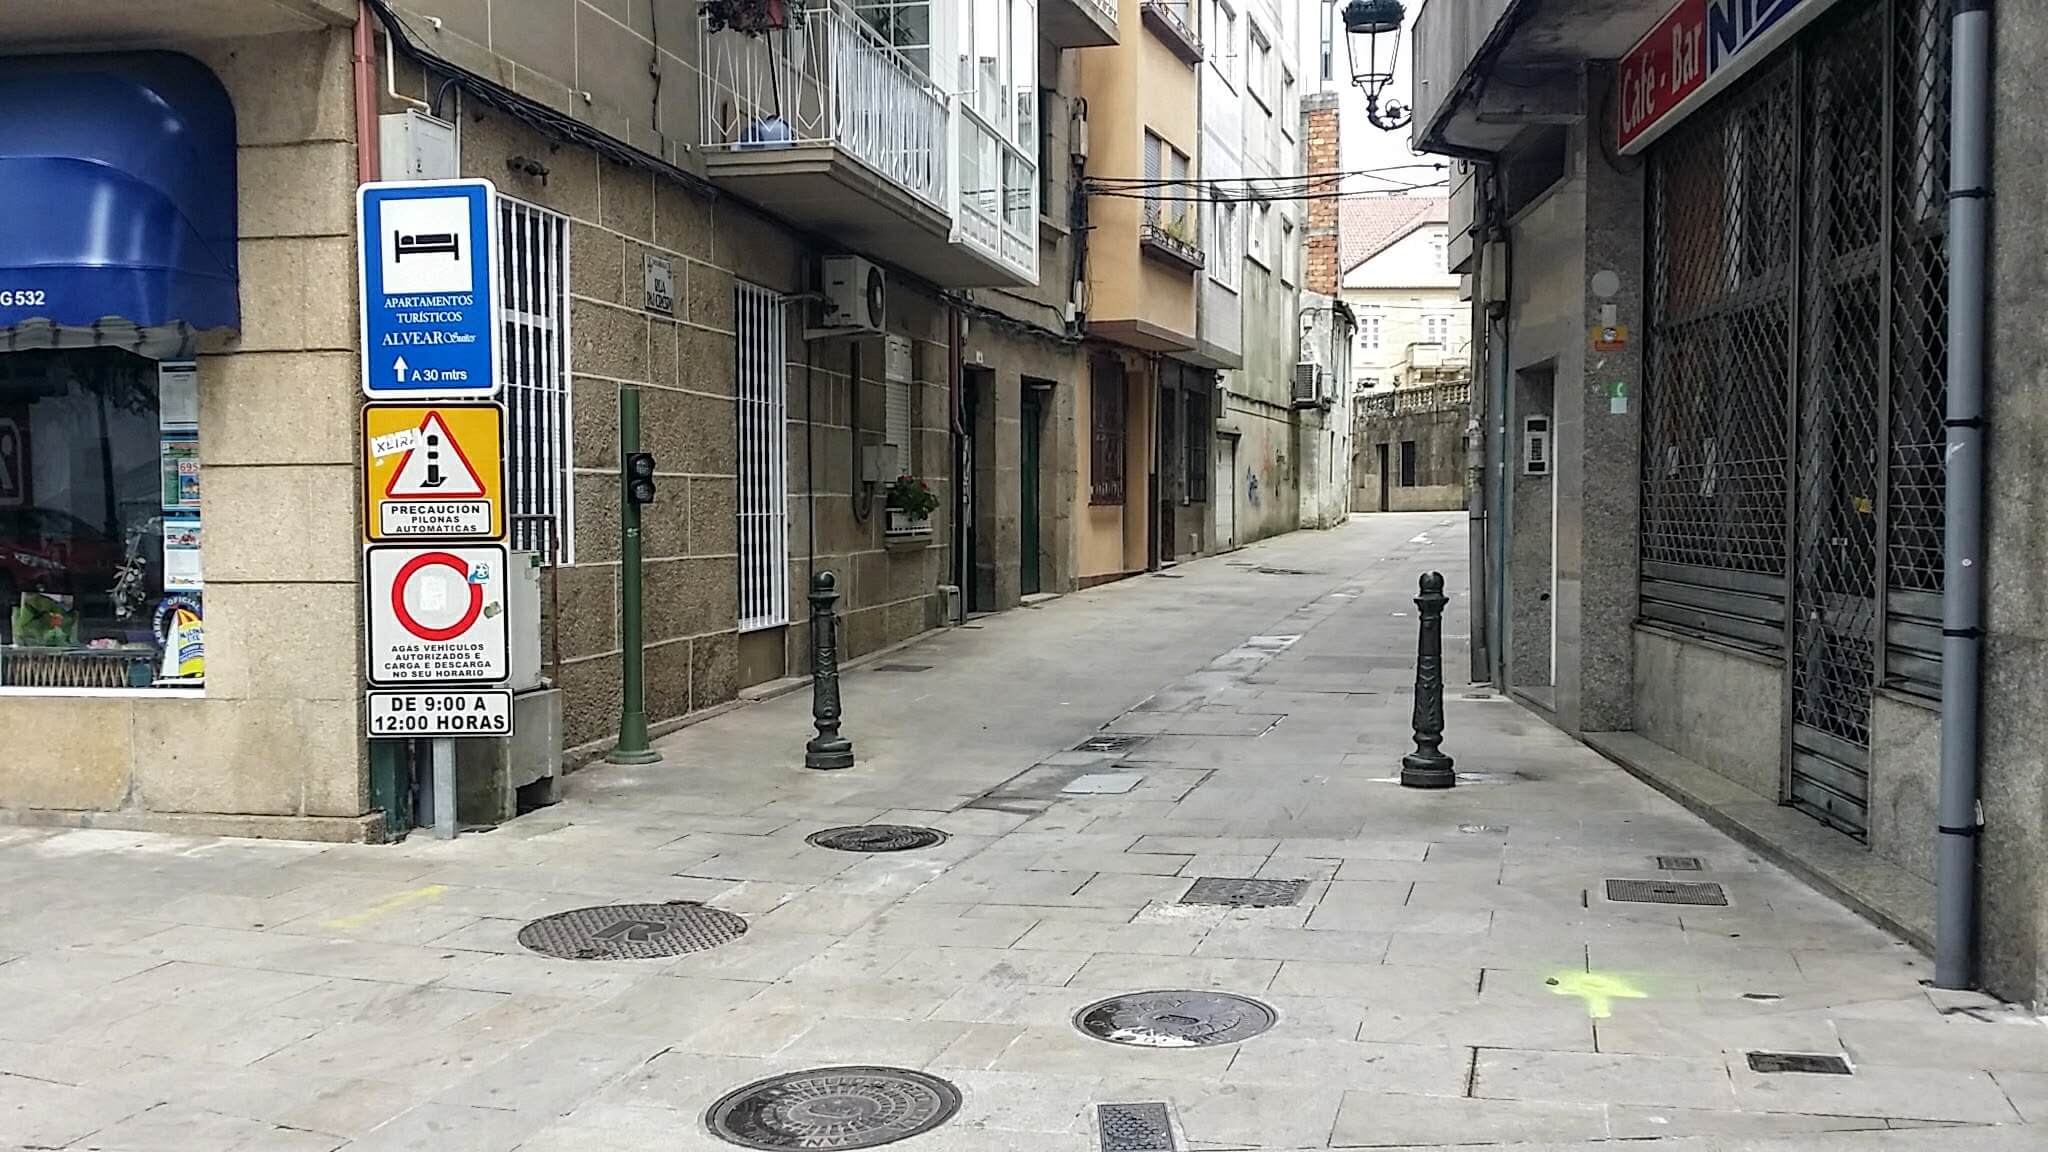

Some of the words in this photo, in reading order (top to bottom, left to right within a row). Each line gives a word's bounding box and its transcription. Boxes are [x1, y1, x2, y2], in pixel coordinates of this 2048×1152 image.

[1622, 52, 1656, 134] Café
[1672, 22, 1702, 95] Bar
[384, 295, 474, 309] APARTAMENTOS
[396, 311, 463, 324] TURÍSTICOS
[412, 371, 421, 381] A
[424, 369, 439, 381] 30
[441, 369, 468, 380] mtrs
[179, 463, 199, 473] 695
[411, 516, 460, 524] PILONAS
[391, 645, 420, 653] AGAS
[395, 653, 471, 661] AUTORIZADOS
[384, 662, 420, 670] CARGA
[434, 661, 492, 669] DESCARGA
[392, 671, 408, 679] NO
[411, 670, 432, 678] SEU
[436, 669, 485, 678] HORARIO
[391, 698, 417, 711] DE
[424, 697, 466, 711] 9:00
[473, 696, 487, 710] A
[375, 715, 428, 730] 12:00
[436, 714, 505, 730] HORAS
